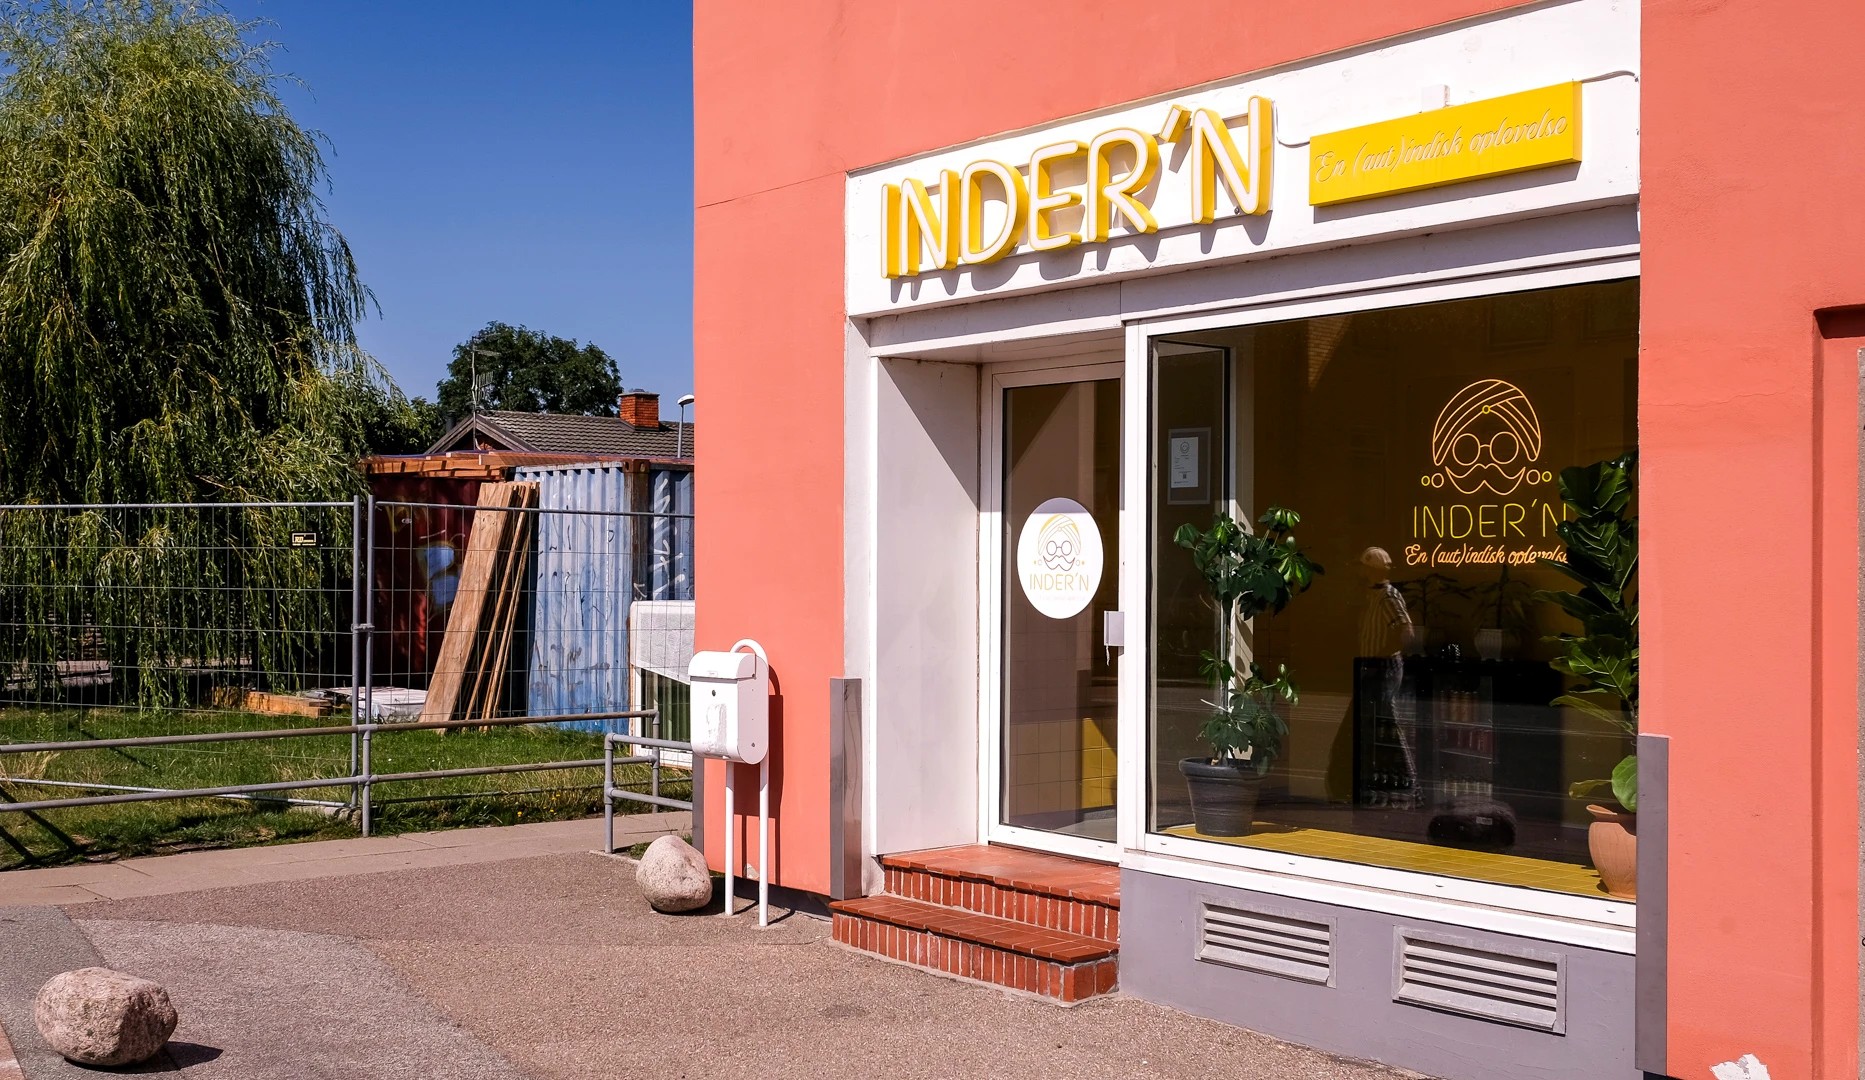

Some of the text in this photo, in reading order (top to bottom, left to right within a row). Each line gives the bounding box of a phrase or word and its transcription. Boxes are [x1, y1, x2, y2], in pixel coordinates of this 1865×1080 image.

[1314, 108, 1569, 182] En (aut)indisk oplevelse
[881, 95, 1273, 279] INDER'N
[1413, 498, 1567, 539] INDER'N
[1404, 543, 1428, 566] En
[1431, 542, 1506, 567] (aut)indisk
[1029, 571, 1090, 592] INDER'N
